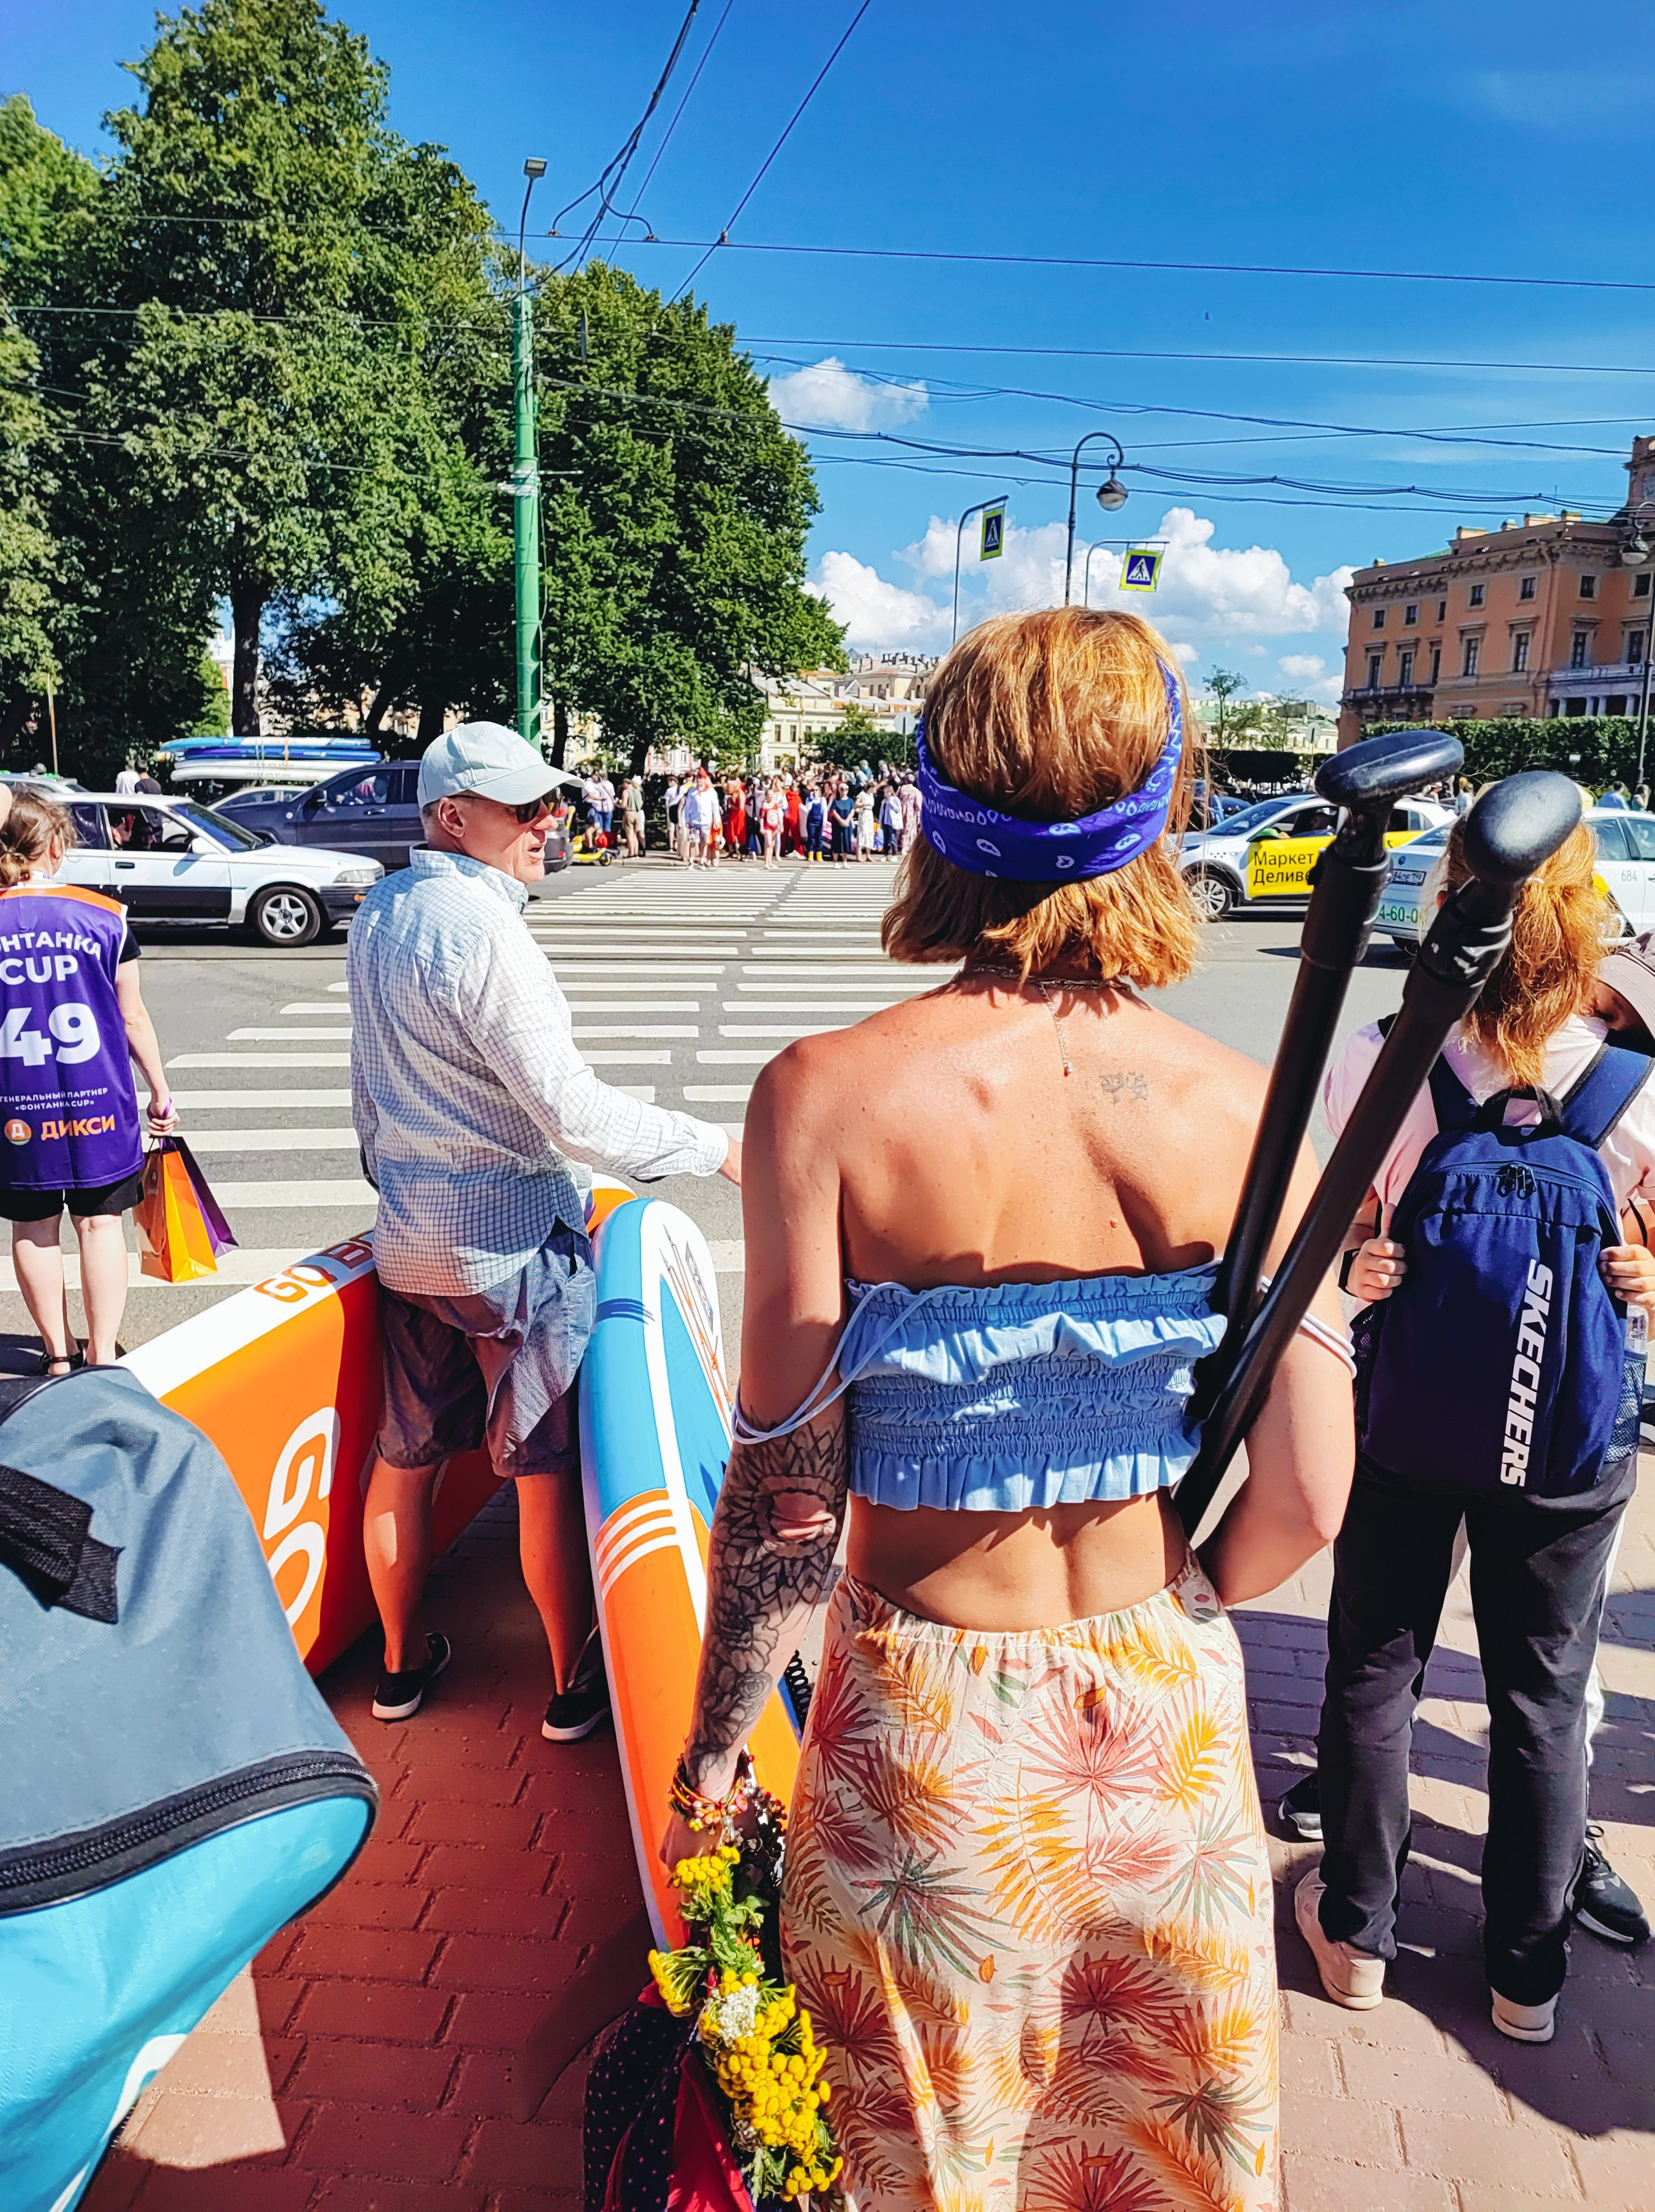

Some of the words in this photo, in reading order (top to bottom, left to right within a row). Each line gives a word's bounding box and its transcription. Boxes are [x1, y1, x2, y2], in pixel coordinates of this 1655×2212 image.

[1254, 851, 1314, 867] Маркет
[1621, 869, 1637, 882] 684
[0, 931, 101, 961] НТАНКА
[0, 955, 78, 985] CUP
[0, 1003, 100, 1067] 49
[67, 1087, 108, 1098] ПАРТНЕР
[41, 1114, 115, 1141] ДИКСИ
[1500, 1259, 1553, 1487] SKECHERS
